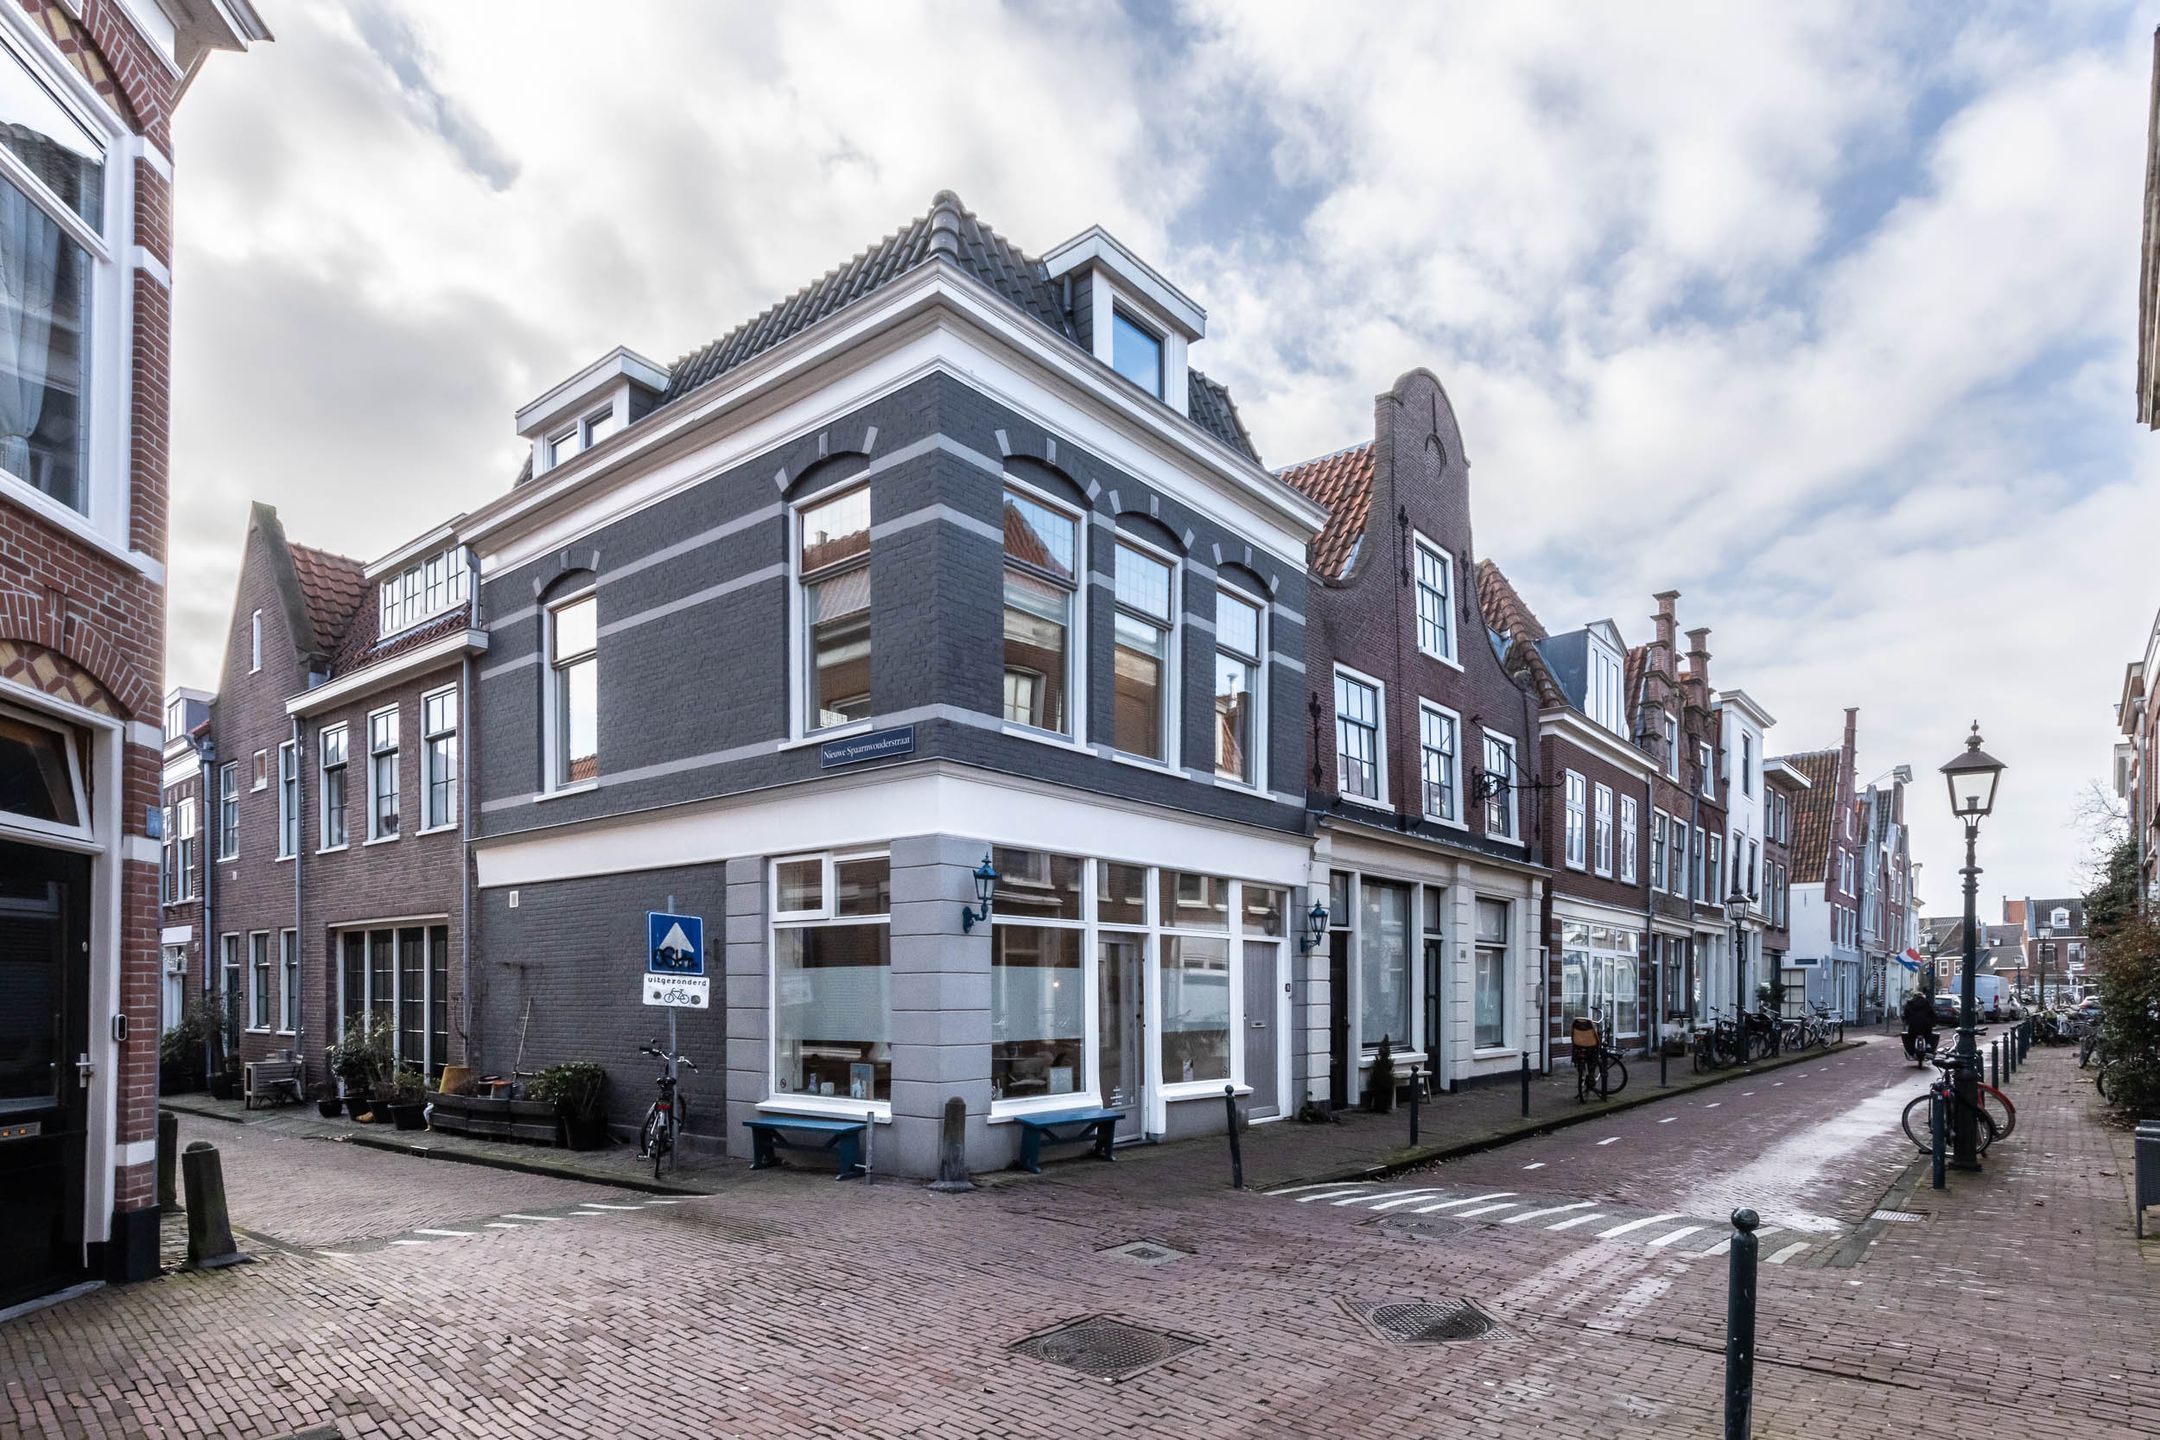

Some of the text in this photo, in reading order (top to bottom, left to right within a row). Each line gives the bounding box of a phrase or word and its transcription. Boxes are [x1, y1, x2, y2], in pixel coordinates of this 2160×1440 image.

[823, 736, 910, 760] Nieuwe Spaarnwouderstraat
[648, 976, 707, 987] uitgezonderd
